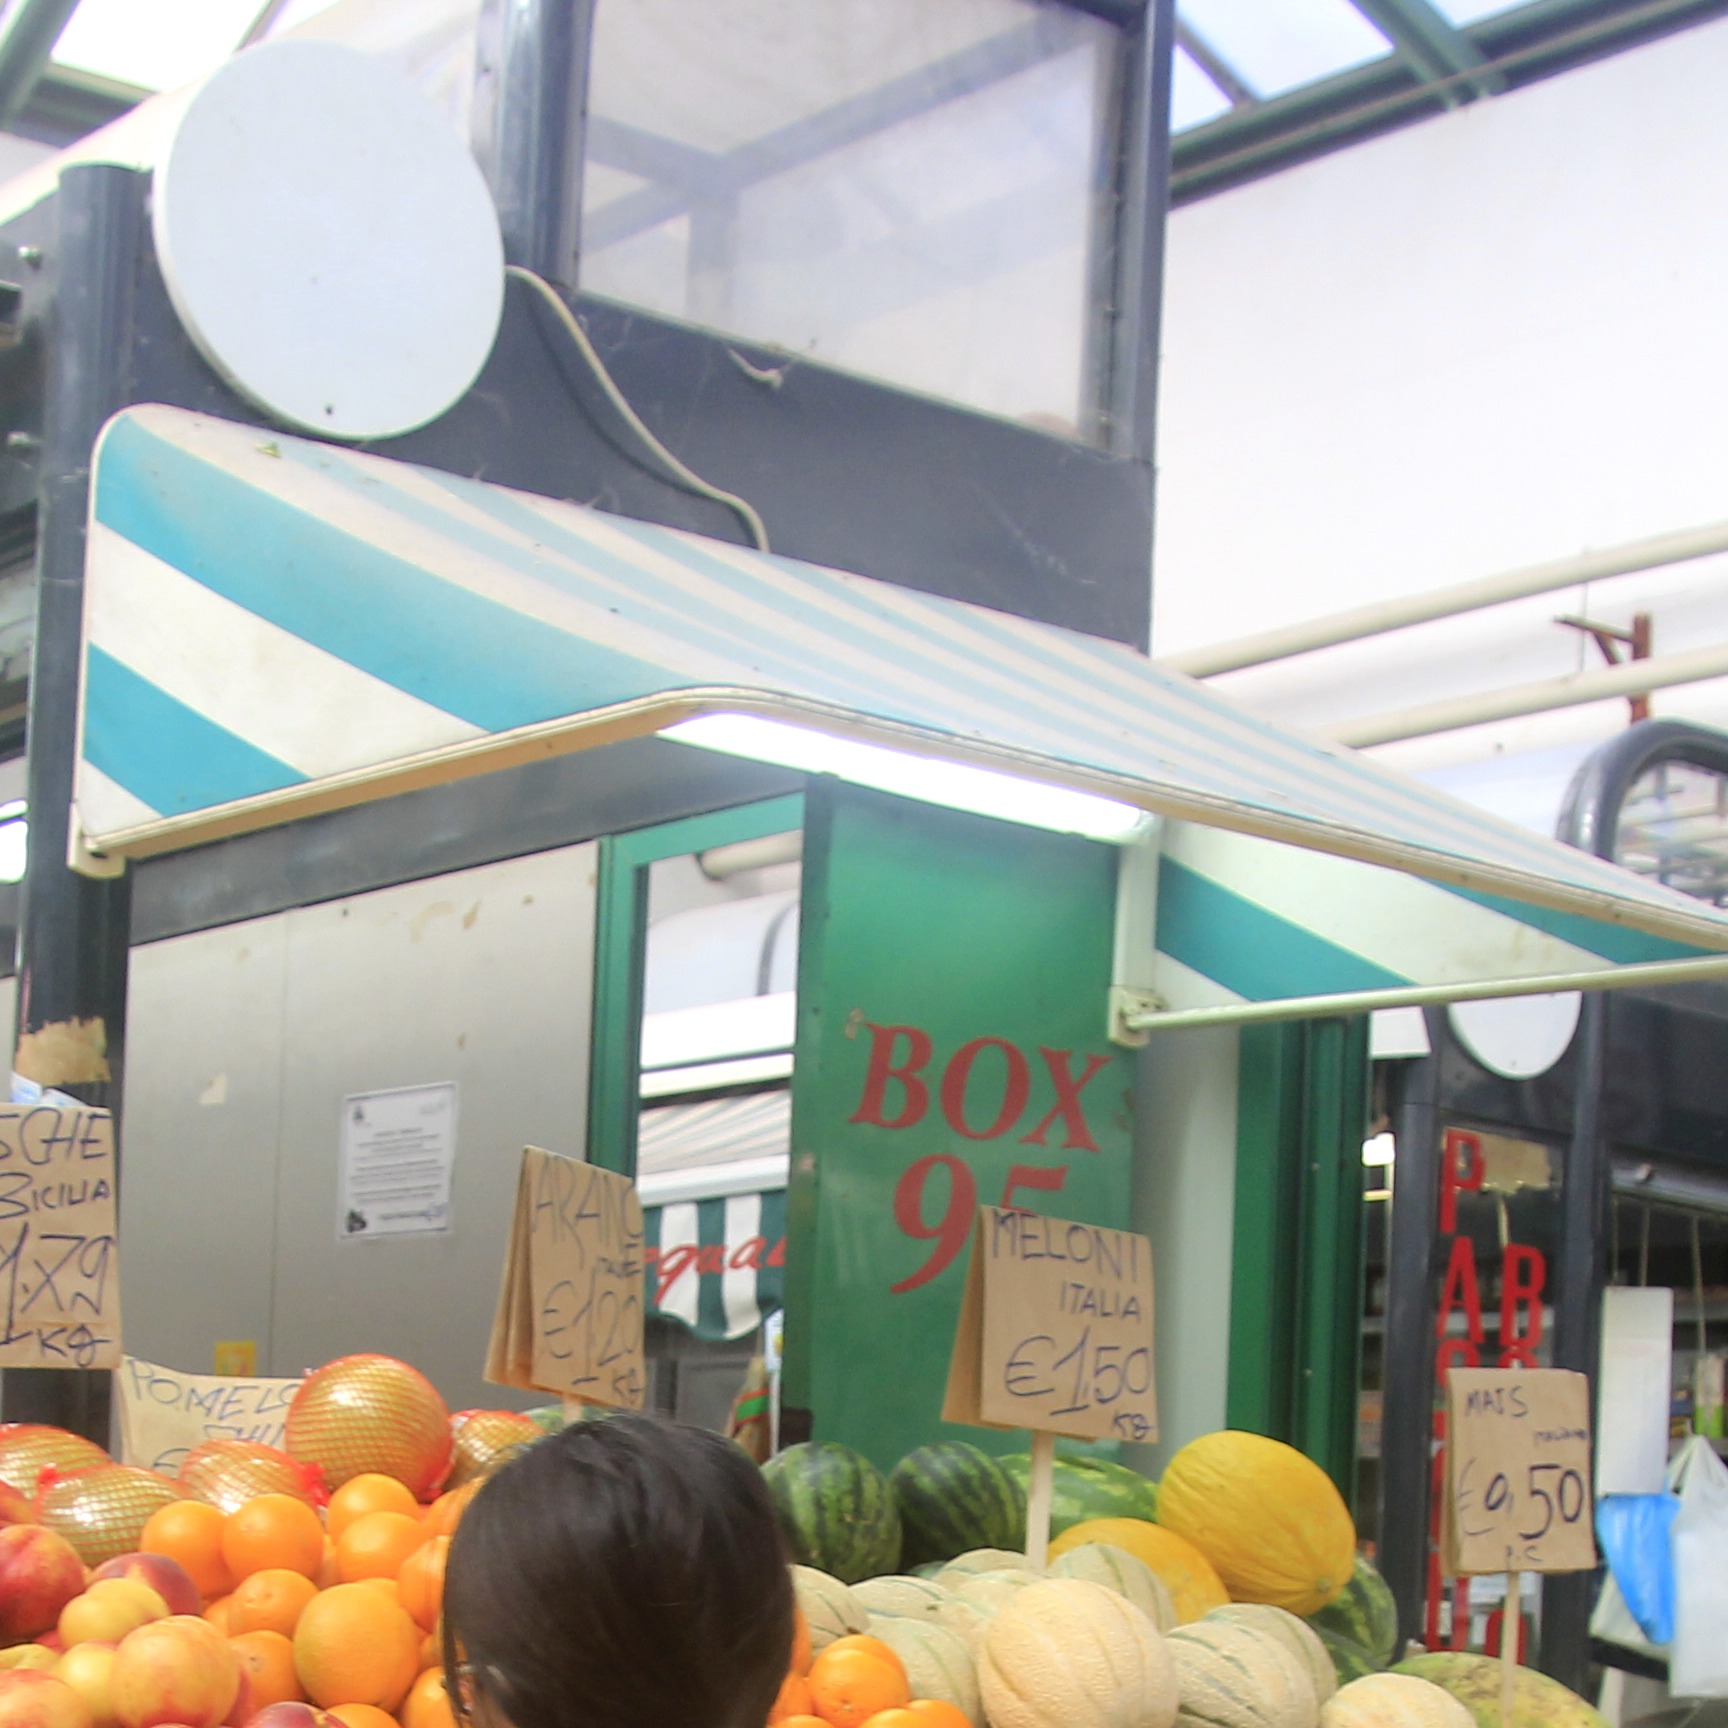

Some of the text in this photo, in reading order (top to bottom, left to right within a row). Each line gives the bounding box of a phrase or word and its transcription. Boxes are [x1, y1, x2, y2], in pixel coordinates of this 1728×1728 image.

[848, 1022, 1112, 1152] BOX
[992, 1207, 1141, 1284] MELONI
[1060, 1281, 1143, 1323] ITALIA
